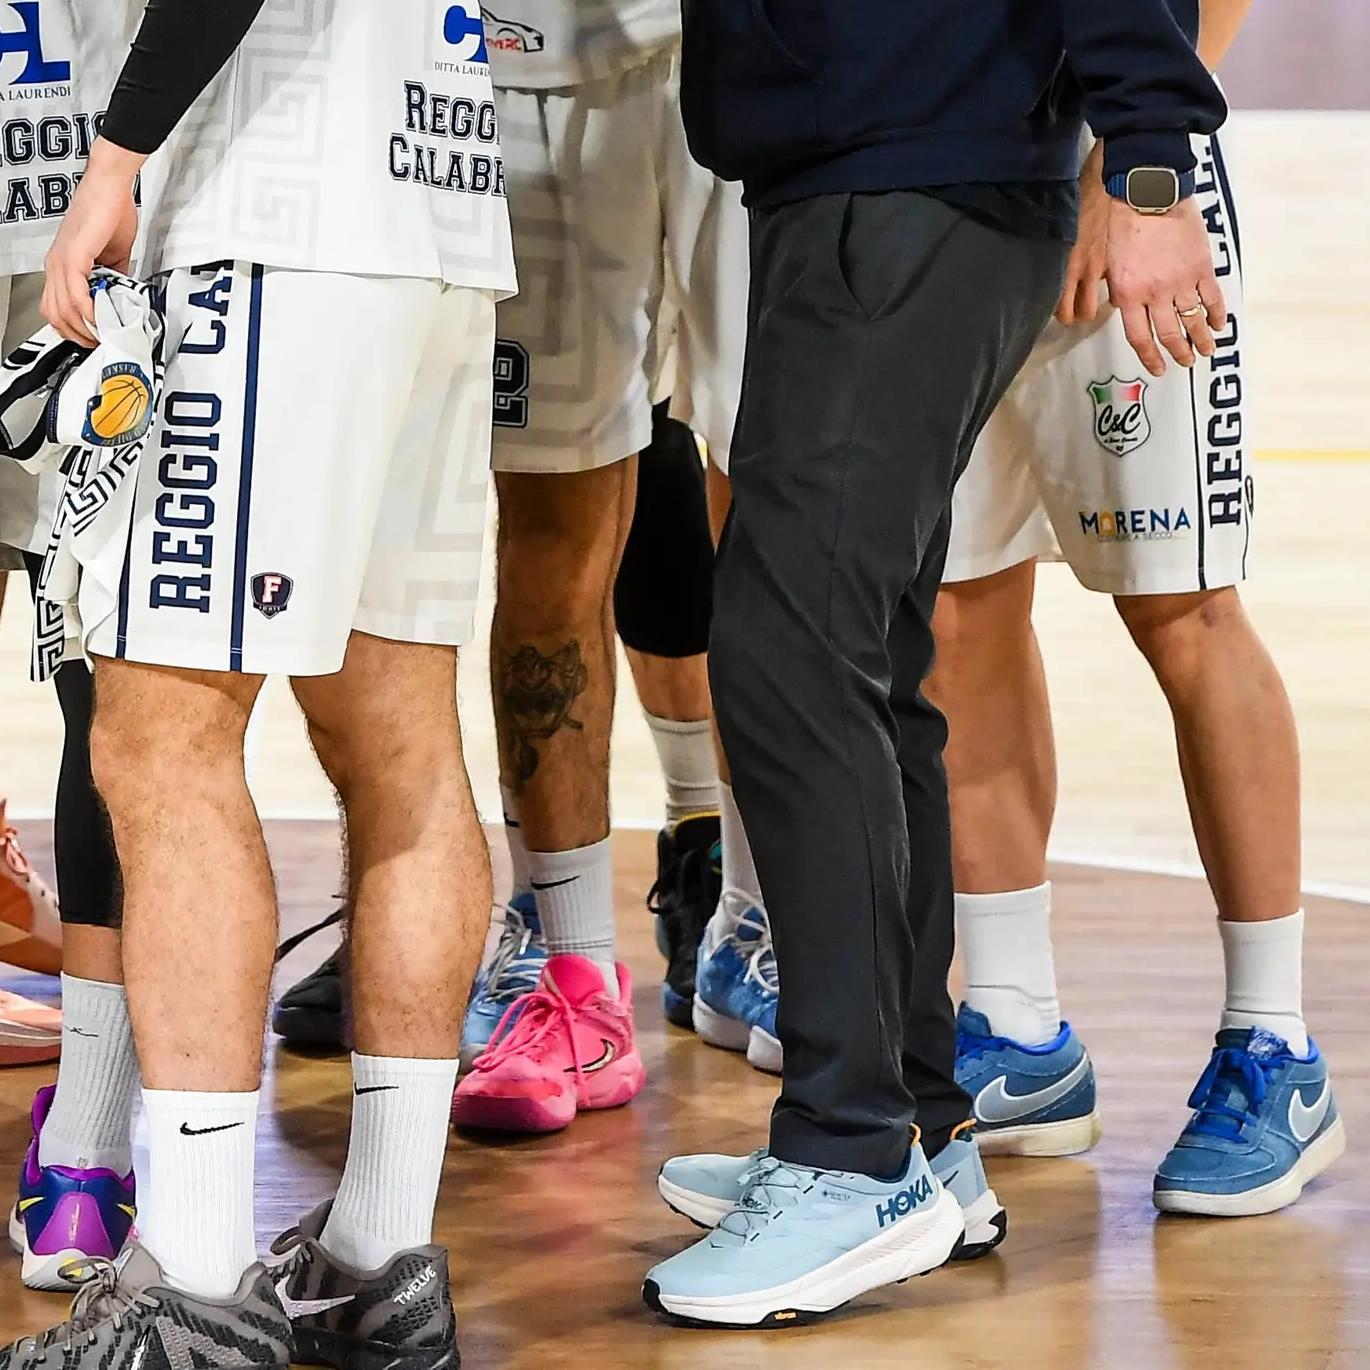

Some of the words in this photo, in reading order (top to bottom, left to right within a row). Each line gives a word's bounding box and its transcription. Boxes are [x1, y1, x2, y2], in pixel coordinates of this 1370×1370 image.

[434, 61, 460, 74] DITTA
[8, 86, 72, 101] LAURENDI
[404, 80, 500, 146] REGG
[149, 391, 222, 613] REGGIO
[262, 575, 282, 603] F
[875, 1174, 934, 1228] HOKA
[393, 1265, 437, 1305] TWELVE
